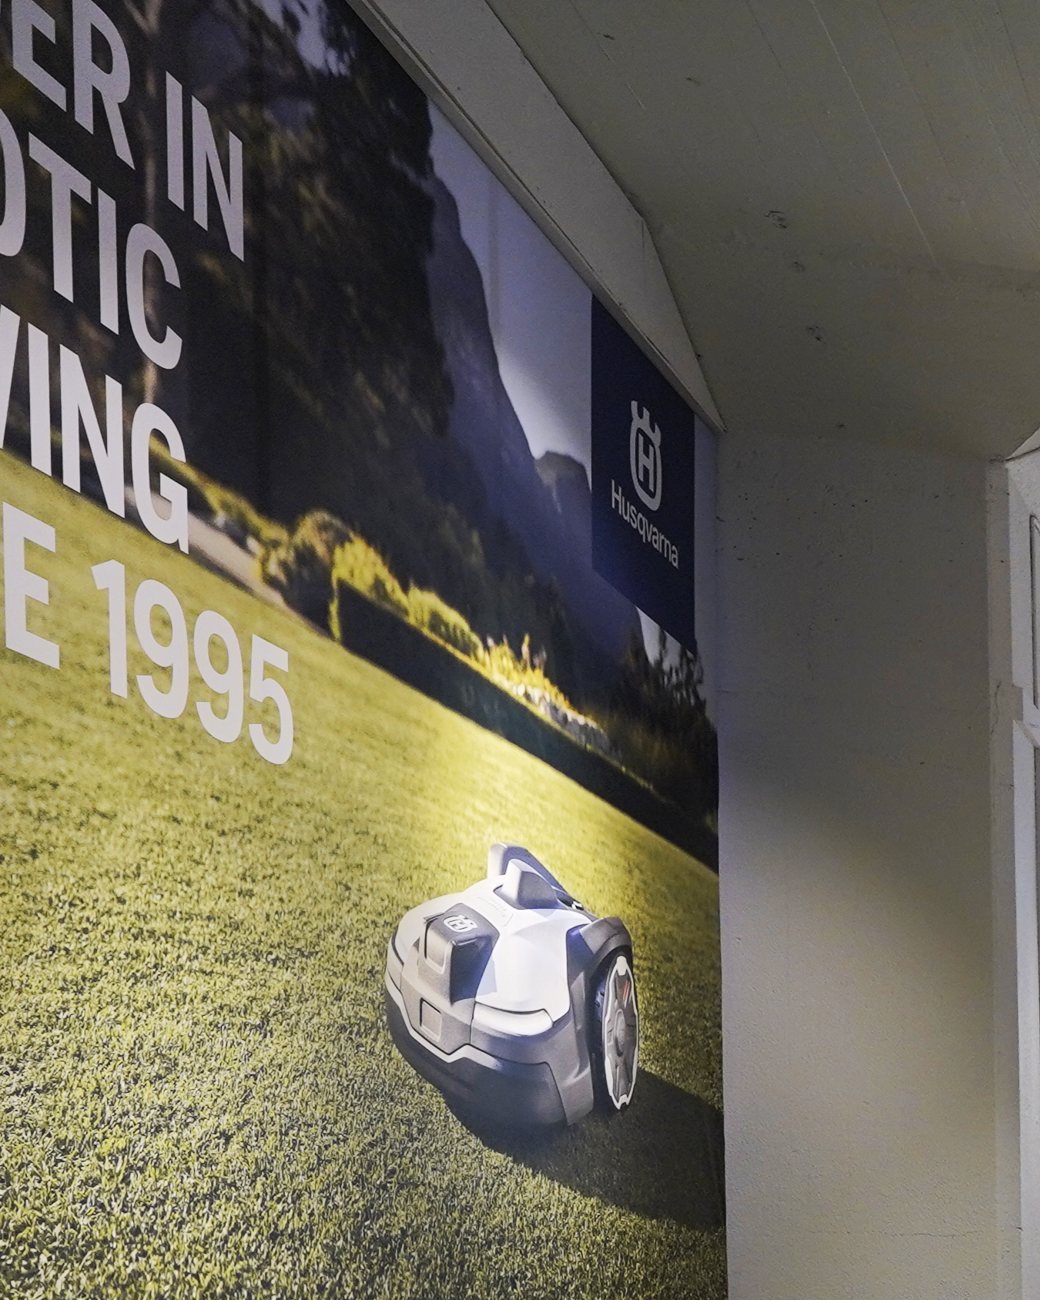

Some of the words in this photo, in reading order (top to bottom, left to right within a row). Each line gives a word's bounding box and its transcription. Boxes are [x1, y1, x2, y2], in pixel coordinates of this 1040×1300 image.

[165, 70, 245, 262] IN
[0, 304, 189, 554] ING
[611, 479, 679, 569] Husqvarna
[3, 502, 60, 670] E
[90, 559, 294, 765] 1995
